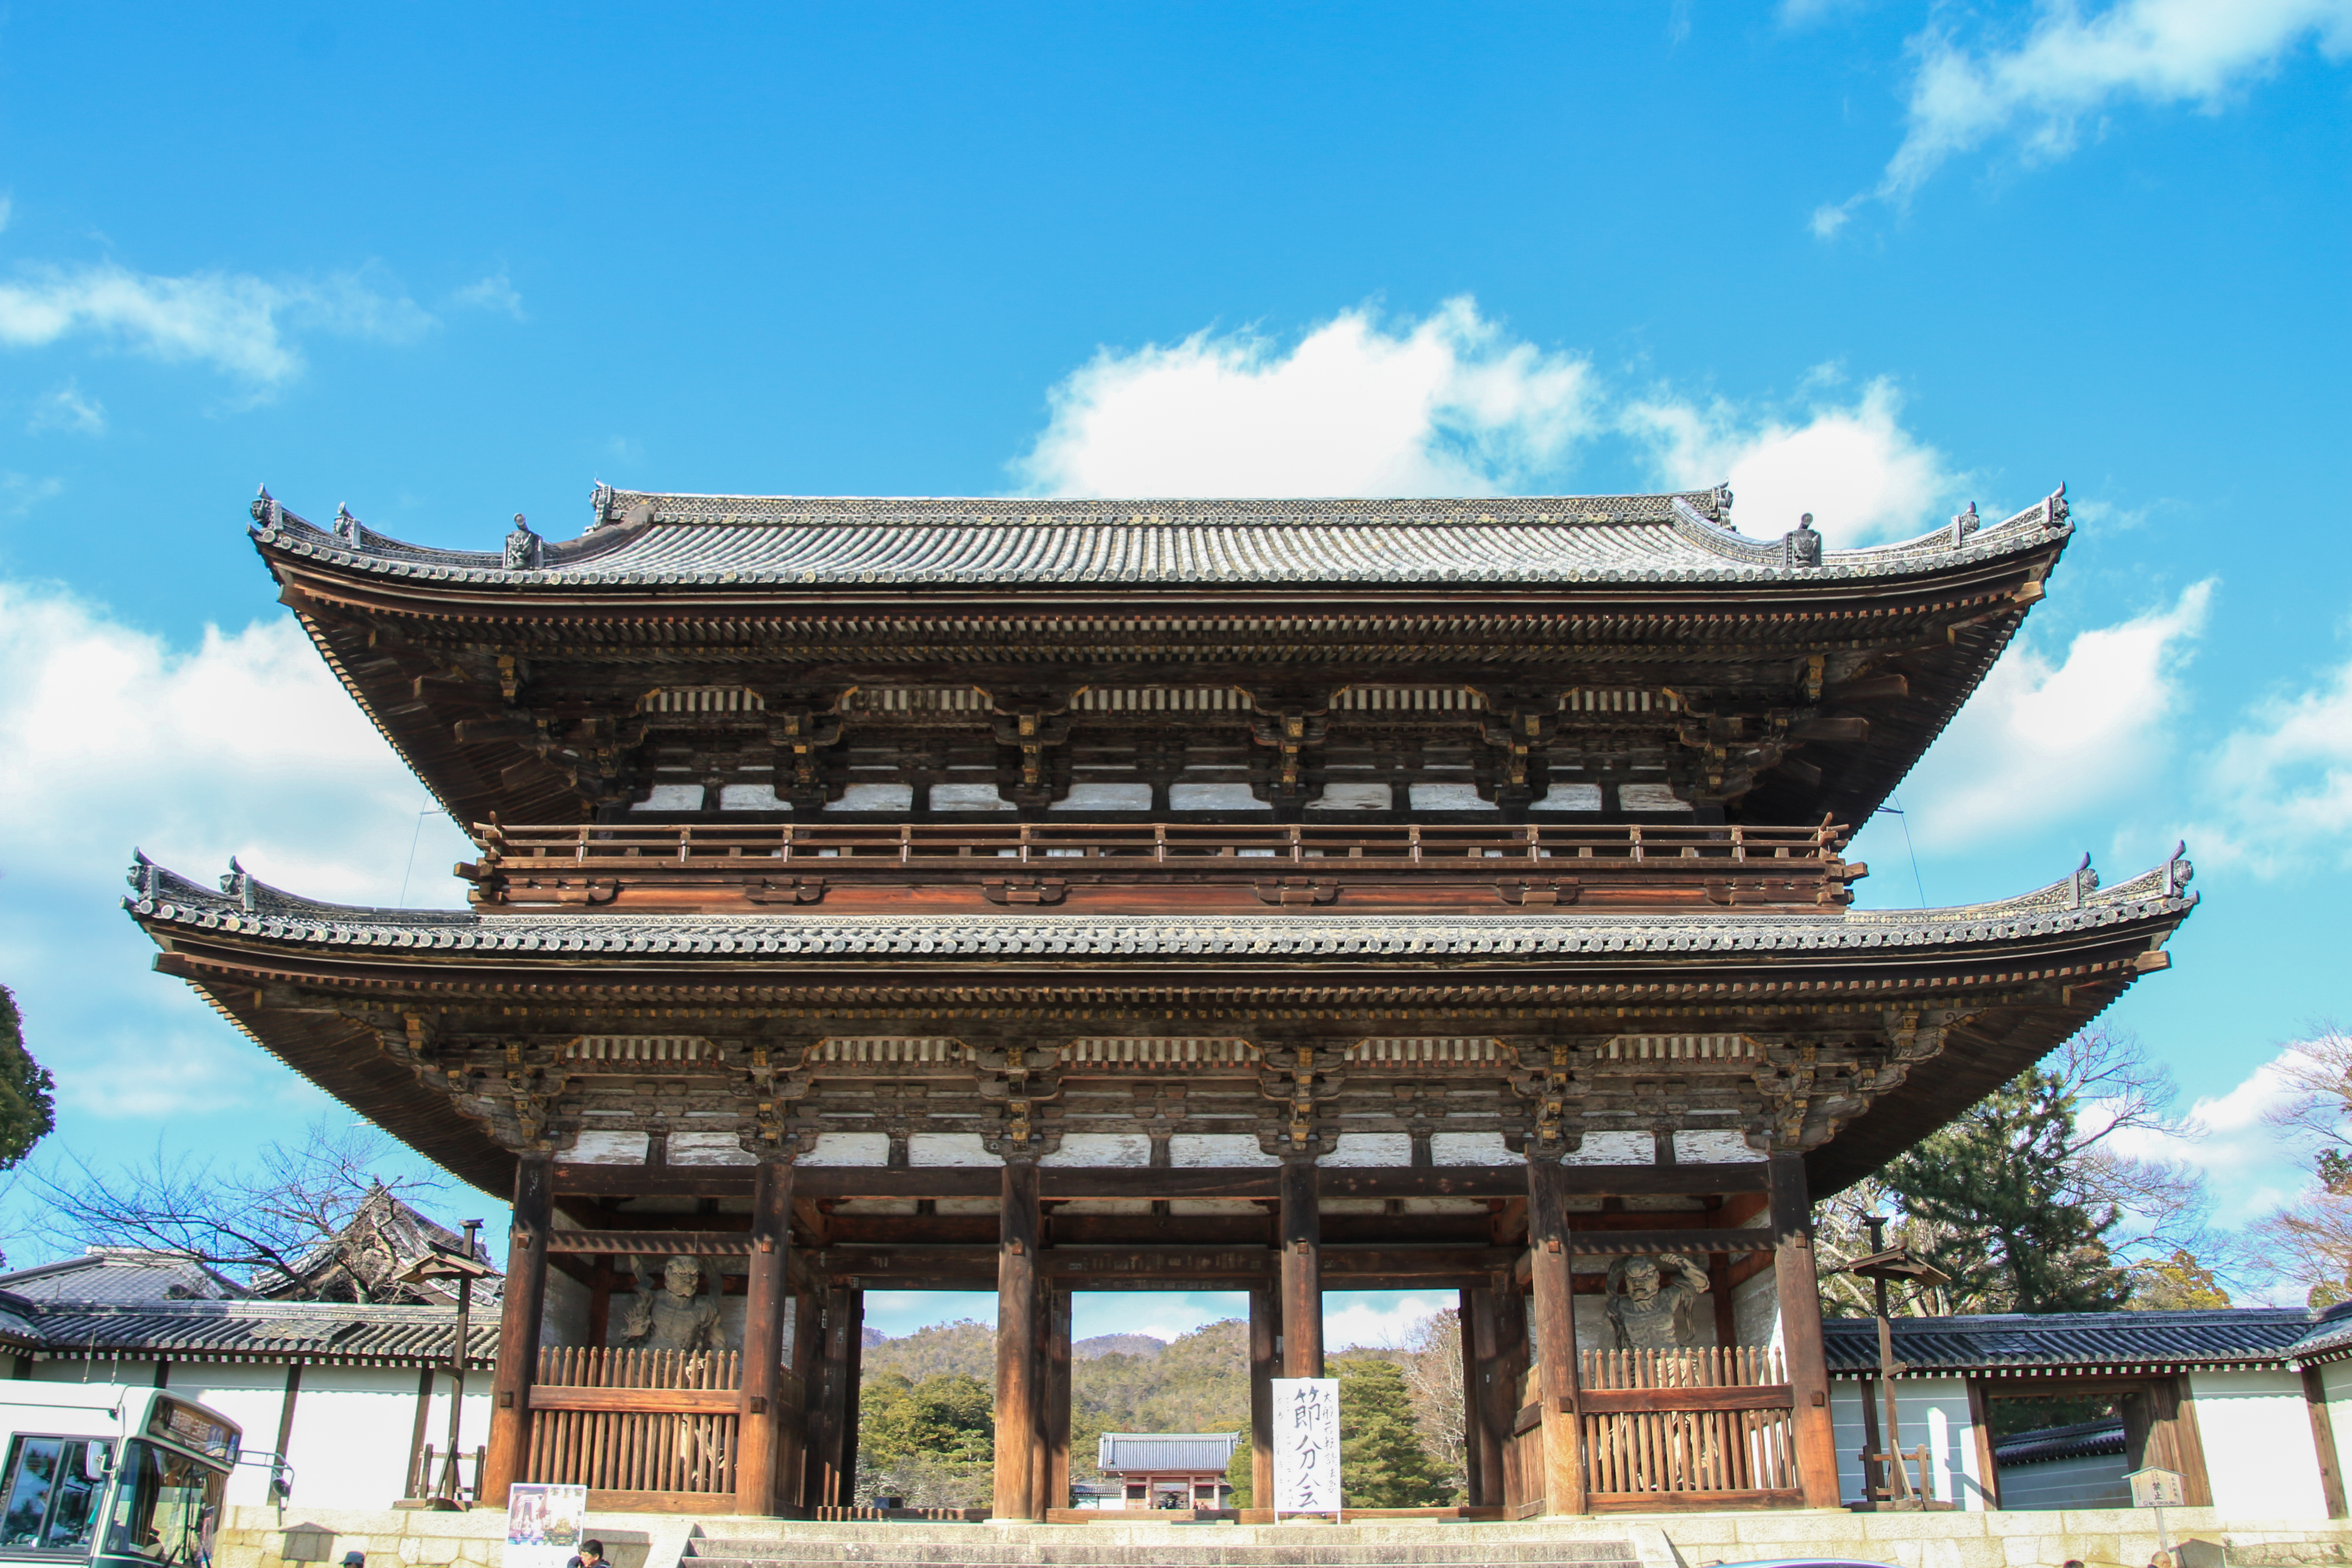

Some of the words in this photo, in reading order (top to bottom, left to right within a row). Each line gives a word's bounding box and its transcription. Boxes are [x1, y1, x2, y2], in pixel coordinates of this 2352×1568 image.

[1293, 1385, 1323, 1508] 節分会
[2152, 1481, 2162, 1500] 禁止
